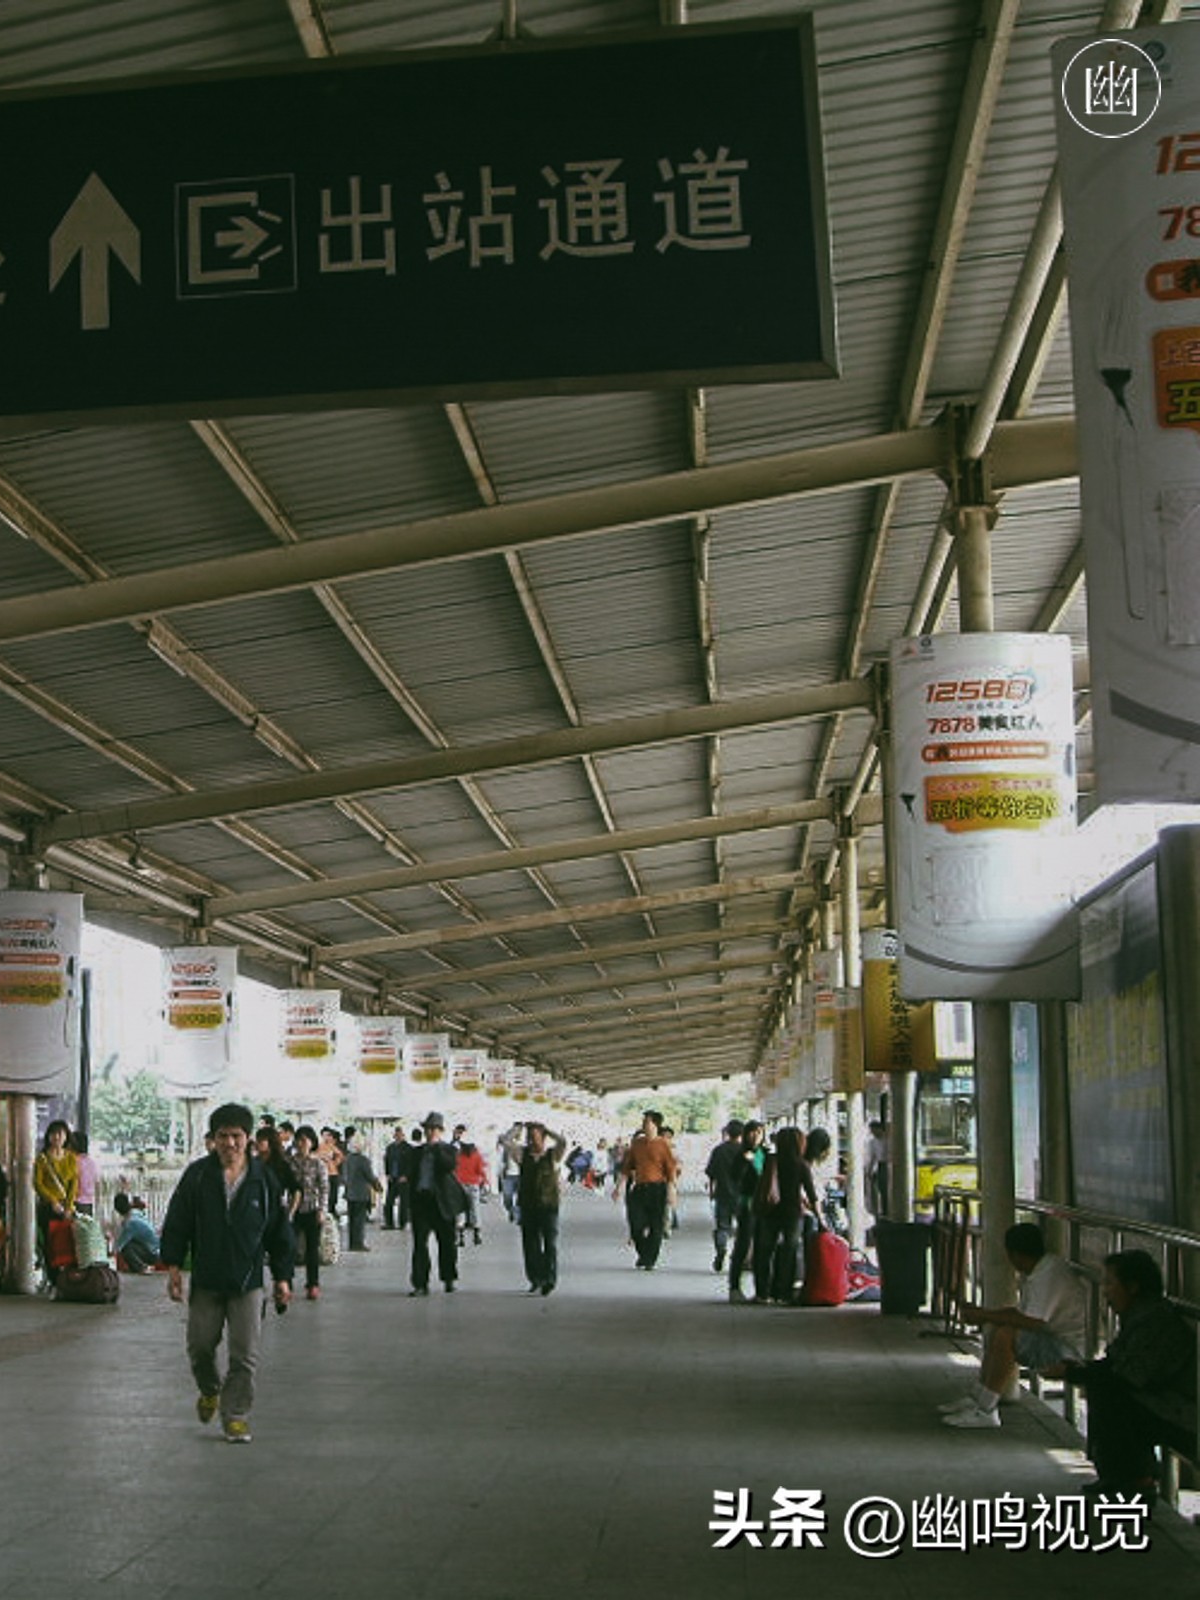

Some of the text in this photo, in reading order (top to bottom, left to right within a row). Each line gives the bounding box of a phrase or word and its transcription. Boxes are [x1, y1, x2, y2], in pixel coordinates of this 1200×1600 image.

[318, 146, 753, 276] 出站通道
[926, 679, 1029, 704] 12580
